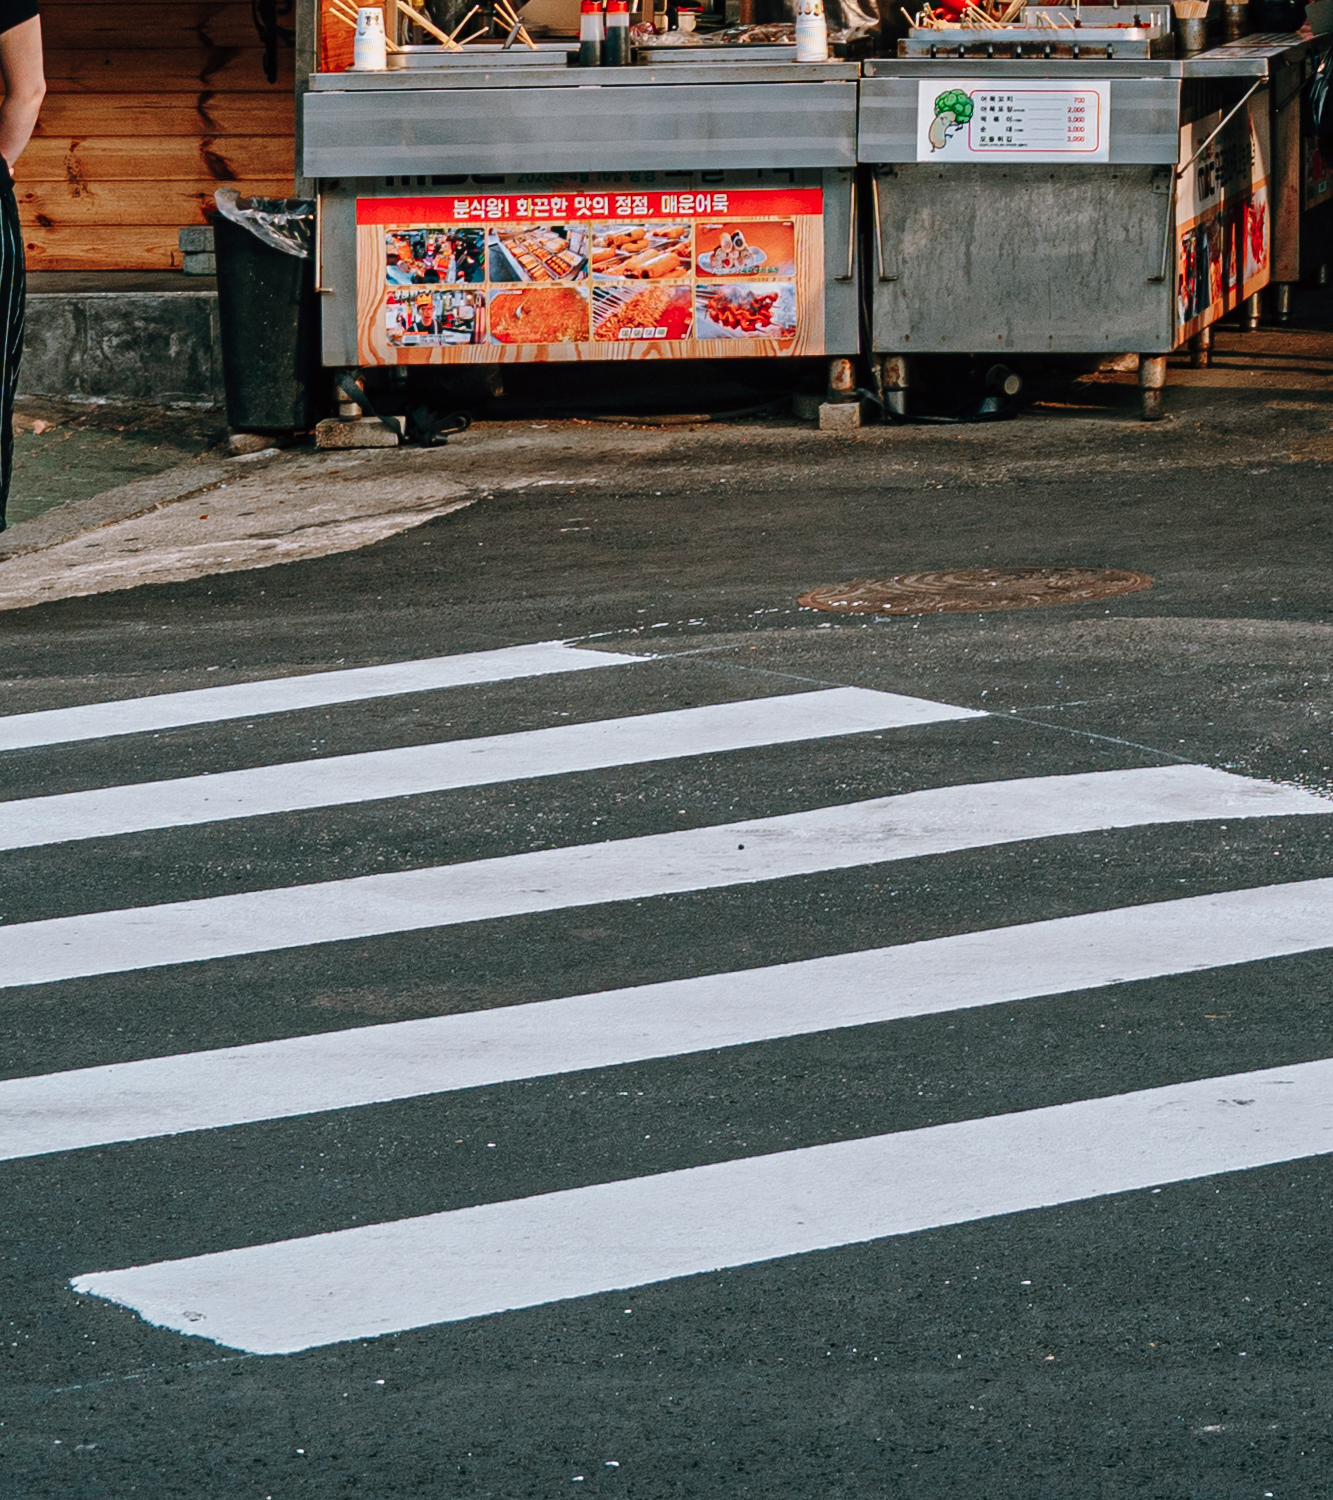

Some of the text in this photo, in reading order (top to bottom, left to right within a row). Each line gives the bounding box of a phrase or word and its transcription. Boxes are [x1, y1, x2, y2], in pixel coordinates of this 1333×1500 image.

[453, 193, 730, 220] 분식왕! 화끈한 맛의 정점, 매운어묵
